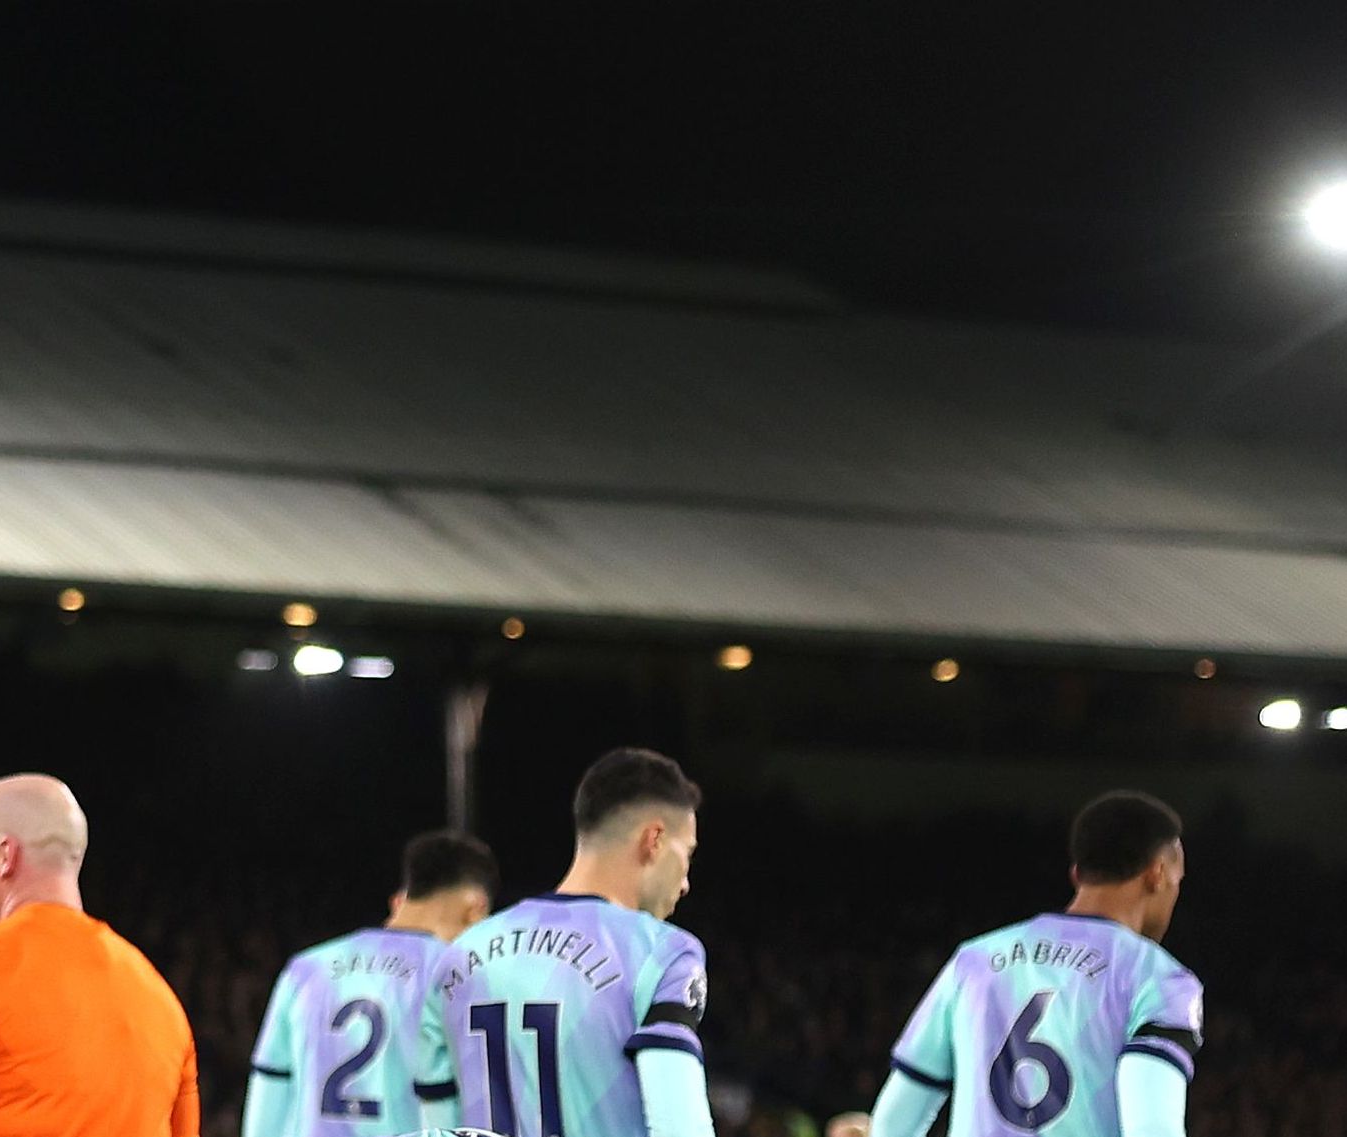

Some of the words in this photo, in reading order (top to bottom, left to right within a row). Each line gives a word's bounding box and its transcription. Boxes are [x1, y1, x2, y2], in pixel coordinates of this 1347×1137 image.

[441, 928, 623, 1001] MARTINELLI
[989, 938, 1109, 982] GABRIEL
[320, 998, 385, 1119] 2
[988, 988, 1072, 1136] 6
